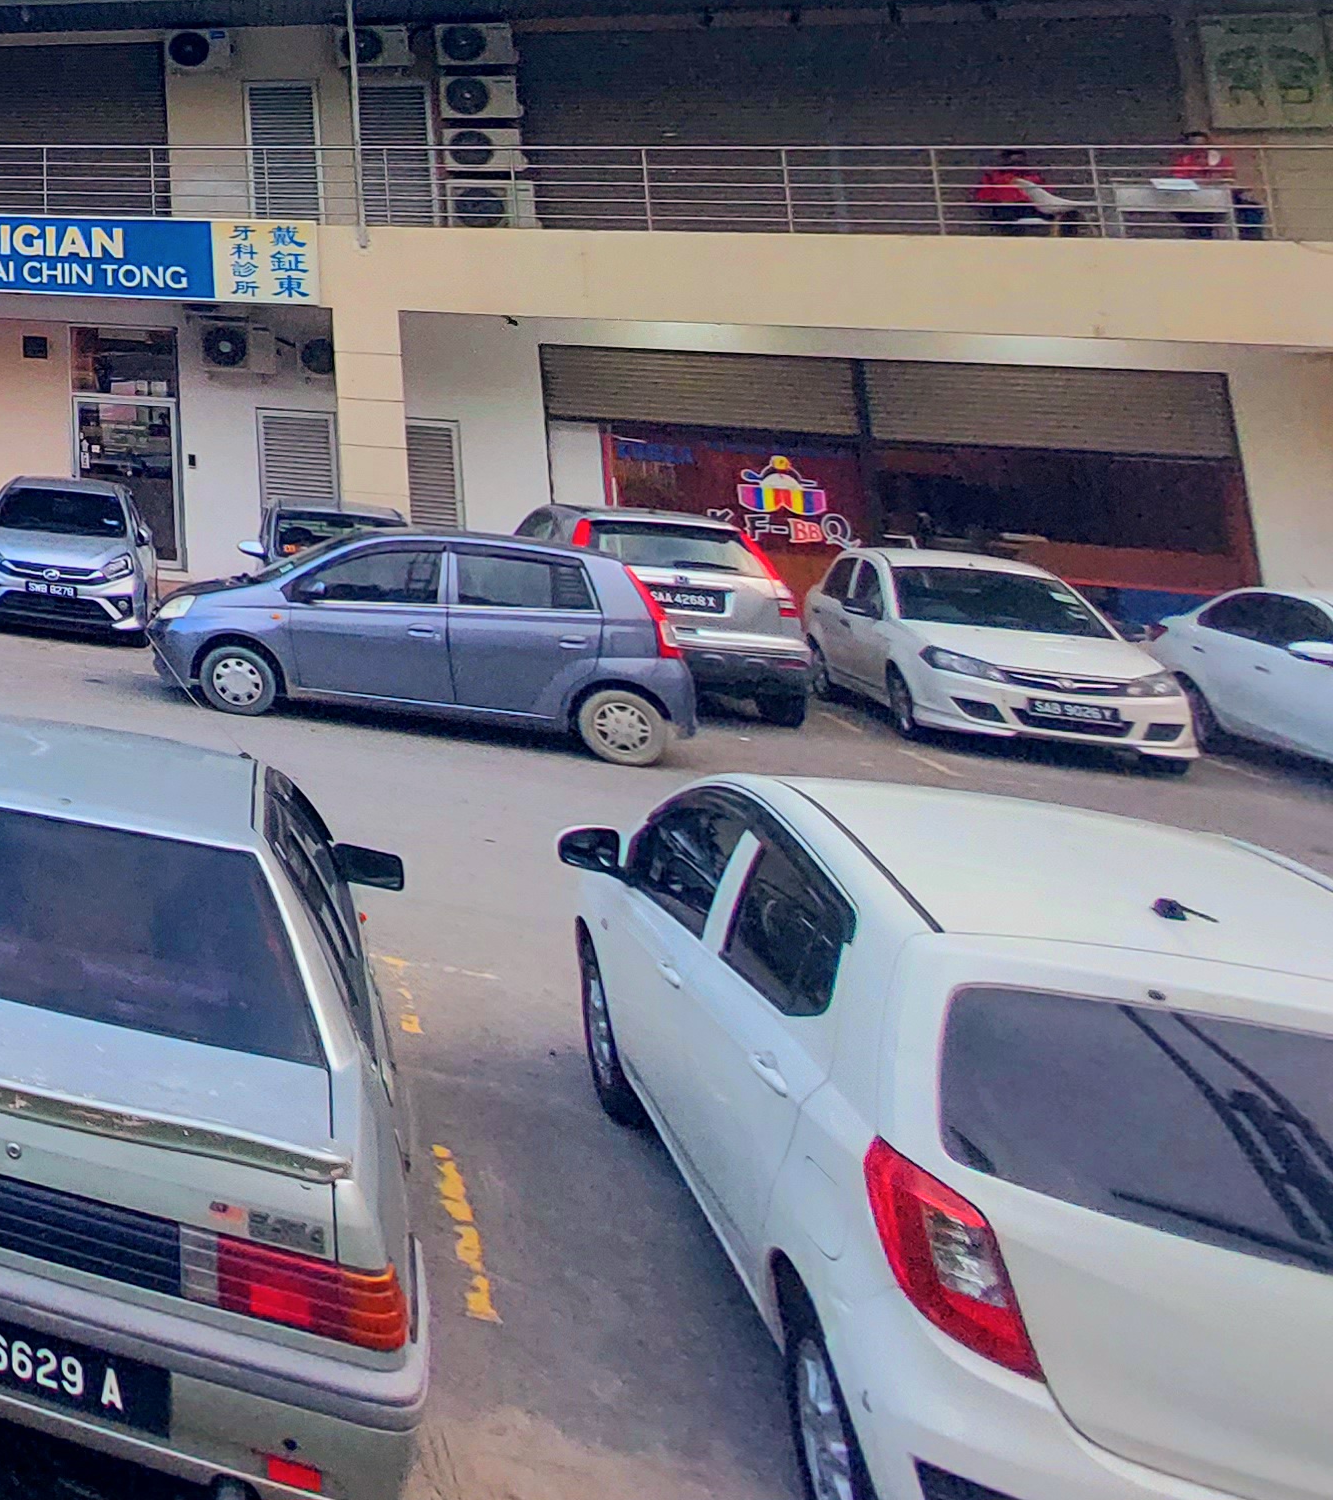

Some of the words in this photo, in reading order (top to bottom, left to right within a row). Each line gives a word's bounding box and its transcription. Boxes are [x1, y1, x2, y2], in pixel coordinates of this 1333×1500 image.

[23, 261, 99, 285] CHIN
[100, 264, 189, 289] TONG
[229, 225, 260, 297] 牙科診所
[650, 590, 673, 603] SAA
[674, 593, 707, 606] 4268
[1034, 700, 1062, 714] SAB
[100, 1367, 124, 1412] A
